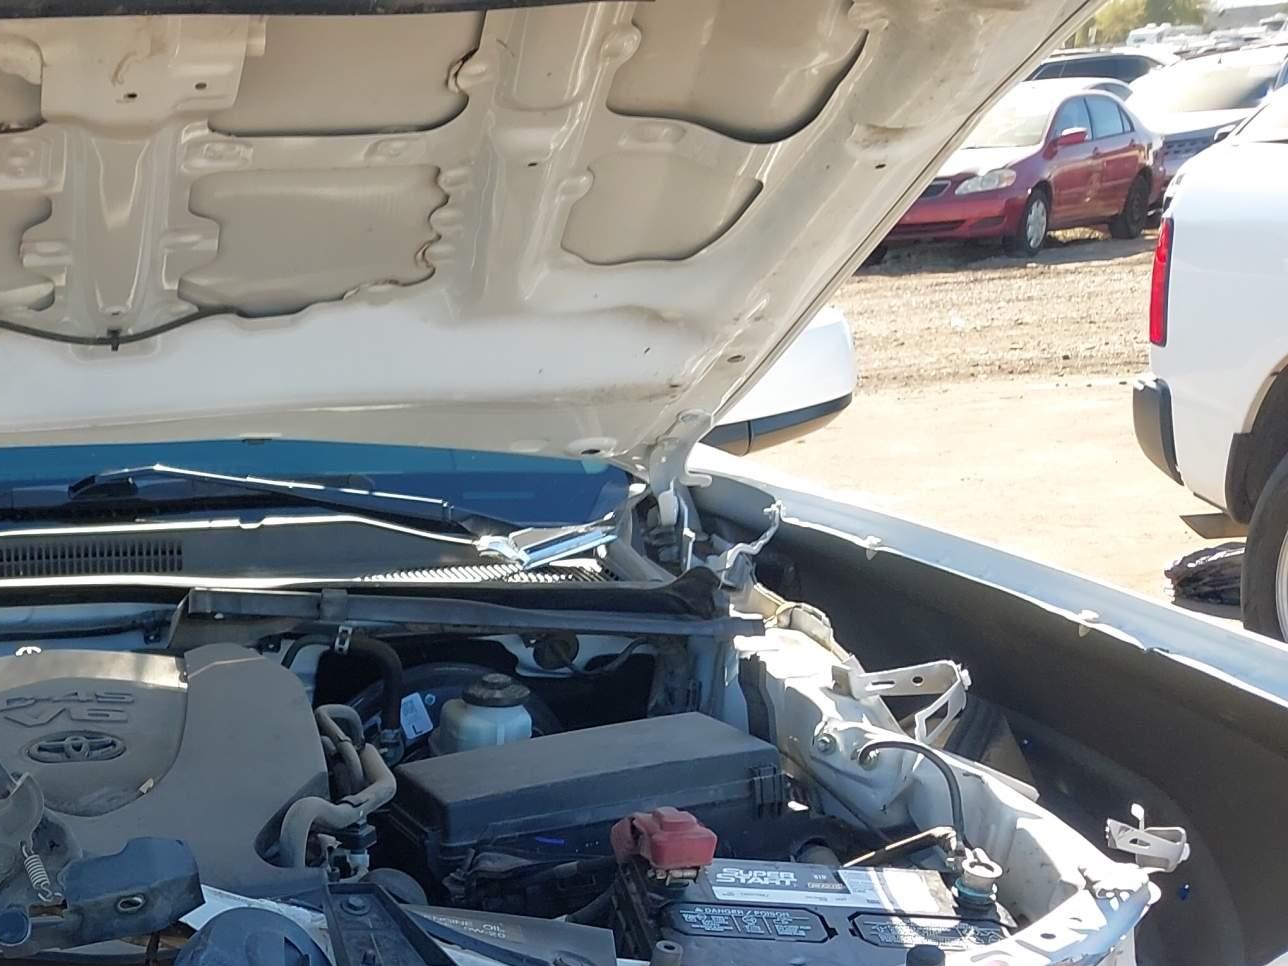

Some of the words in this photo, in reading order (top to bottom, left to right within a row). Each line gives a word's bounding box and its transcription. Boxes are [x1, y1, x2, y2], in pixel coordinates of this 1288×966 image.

[4, 707, 129, 728] V6
[715, 872, 798, 887] START
[721, 867, 794, 880] SUPER
[705, 906, 744, 917] DANGER
[752, 909, 790, 919] POISON
